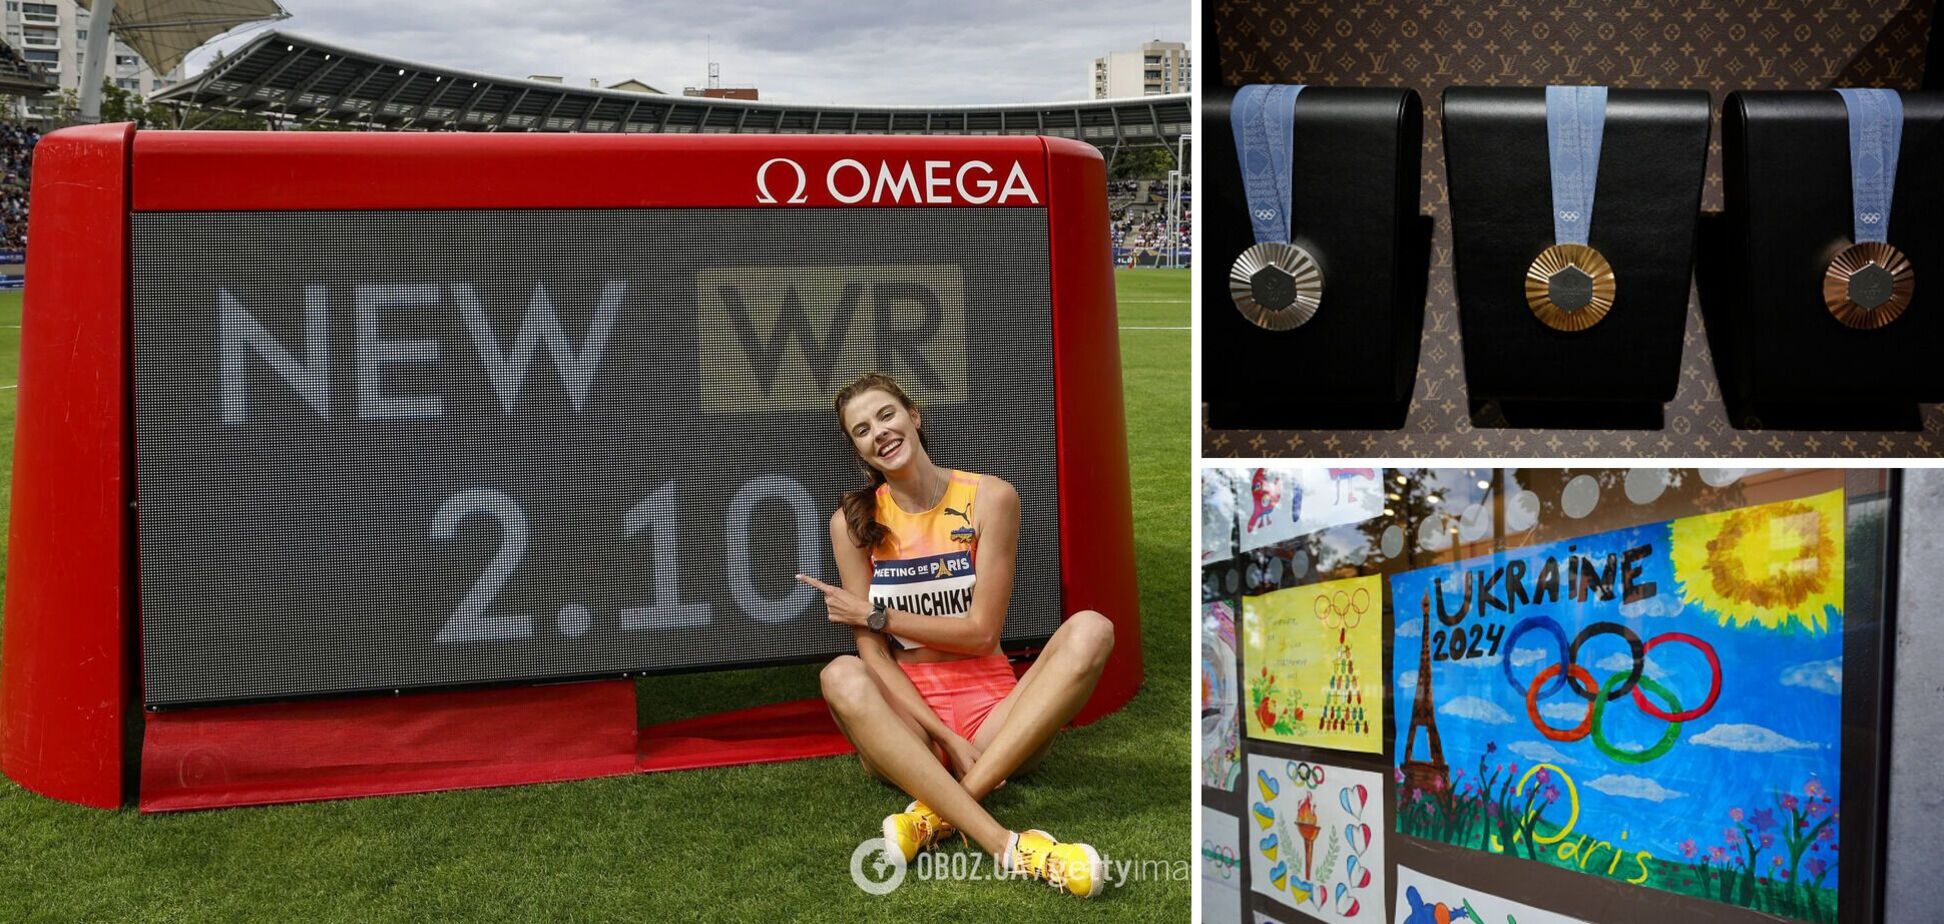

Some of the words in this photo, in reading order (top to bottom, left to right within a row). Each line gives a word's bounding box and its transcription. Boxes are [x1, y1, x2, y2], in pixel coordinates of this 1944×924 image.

[826, 158, 1039, 204] OMEGA
[217, 280, 629, 425] NEW
[719, 282, 946, 397] WR
[431, 473, 824, 645] 2.10
[873, 567, 916, 578] MEETING
[917, 565, 929, 574] DE
[930, 557, 970, 578] PARIS
[1432, 623, 1505, 661] 2024
[1490, 763, 1653, 885] Paris
